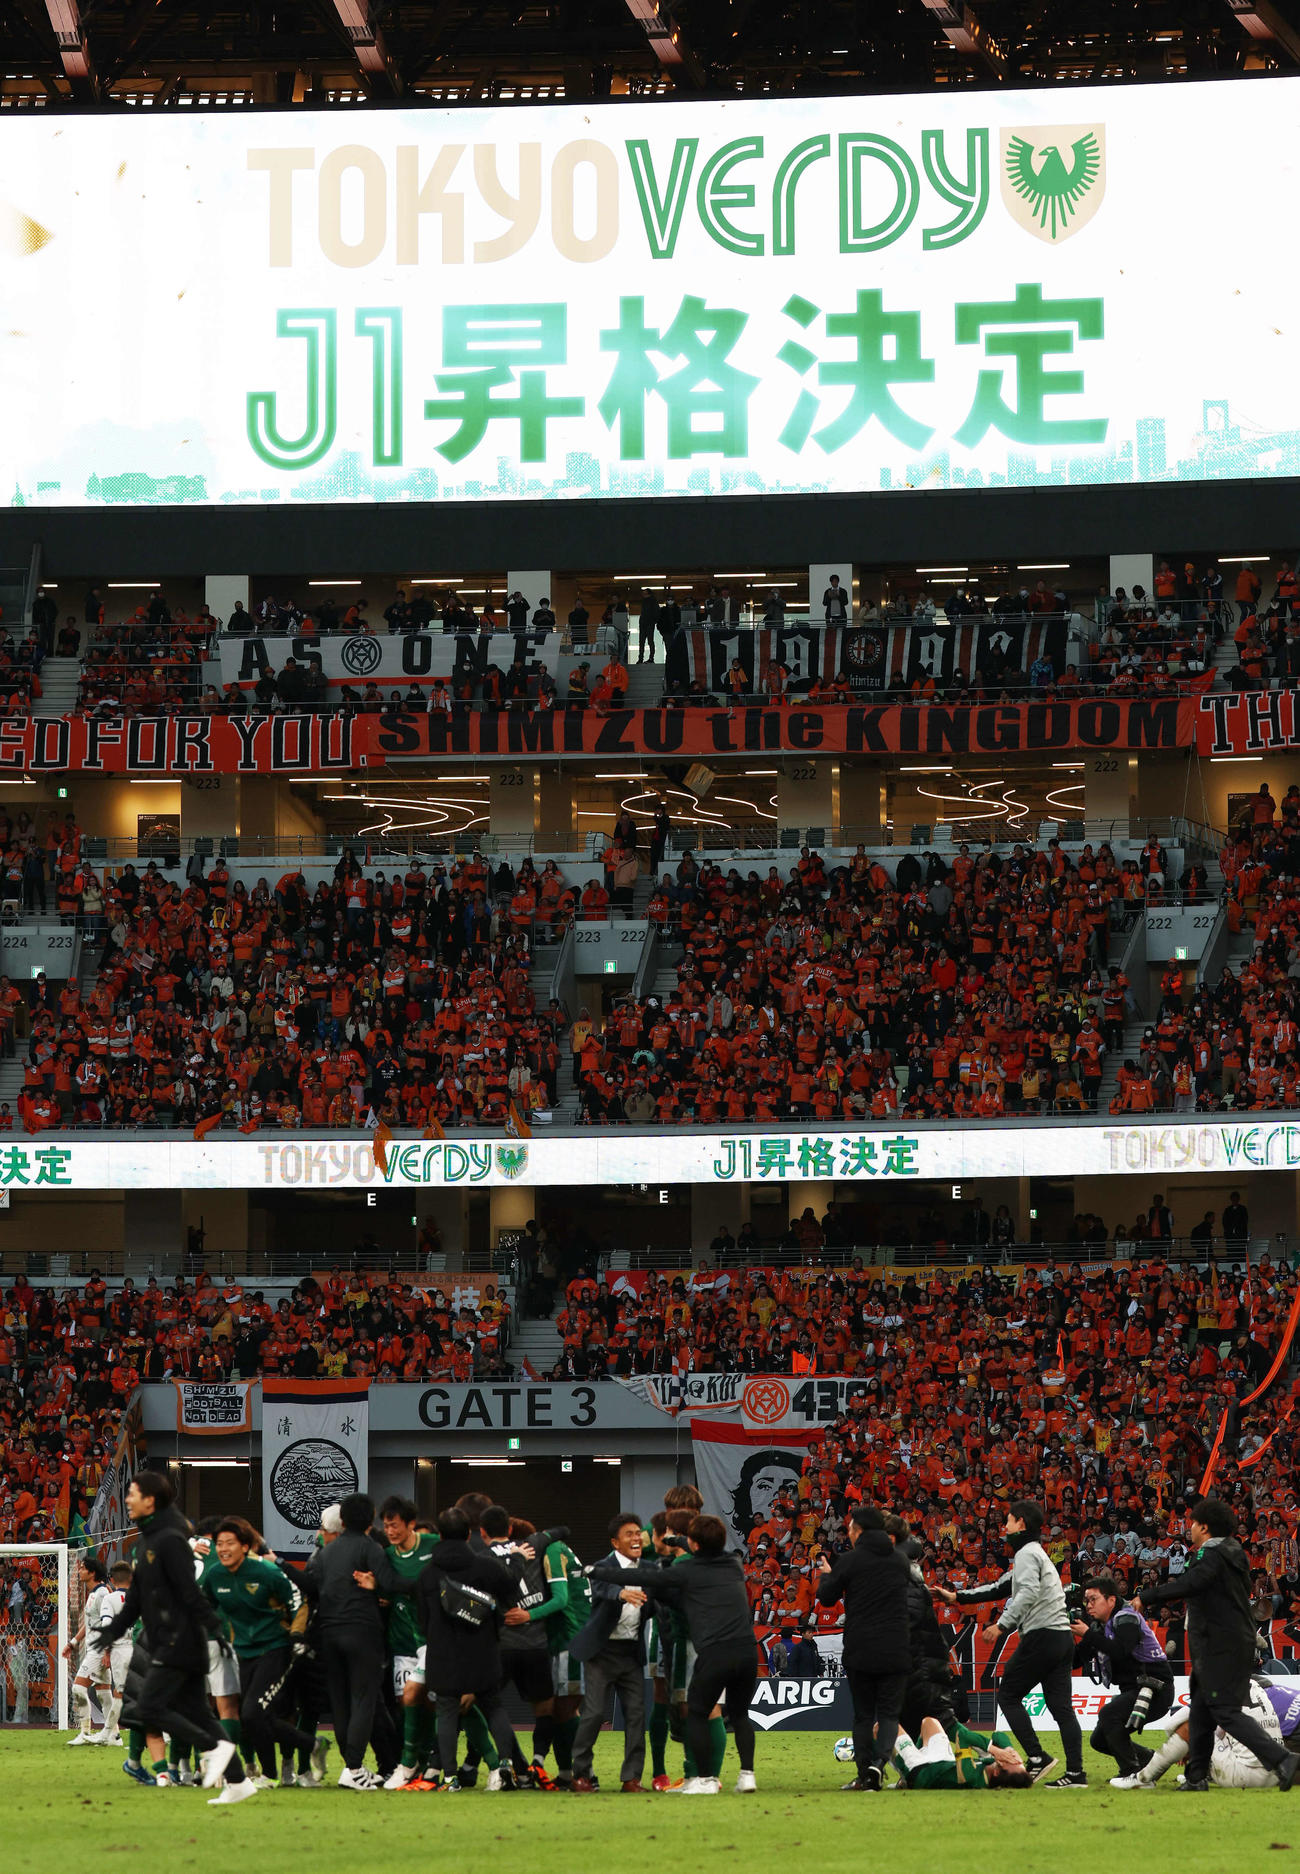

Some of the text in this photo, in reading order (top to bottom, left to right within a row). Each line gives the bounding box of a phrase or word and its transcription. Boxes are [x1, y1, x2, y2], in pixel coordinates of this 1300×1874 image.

[246, 138, 620, 268] TOKYO
[246, 283, 1109, 471] J1昇格決定
[238, 633, 548, 681] AS ONE
[378, 700, 1181, 753] SHIMIZU the KINGDOM
[1200, 689, 1300, 754] TH
[82, 715, 214, 771] FOR
[228, 713, 367, 771] YOU.
[793, 769, 817, 780] 222
[1094, 760, 1119, 772] 222
[196, 778, 221, 790] 223
[500, 774, 524, 786] 223
[1147, 917, 1173, 930] 222
[3, 937, 73, 949] 224 223
[576, 930, 646, 943] 223 222
[714, 1136, 919, 1179] J1昇格決定
[1104, 1128, 1219, 1170] TOKYO
[0, 1146, 72, 1185] 決定
[258, 1145, 375, 1184] TOKYO
[367, 1193, 377, 1206] E
[659, 1190, 669, 1204] E
[952, 1186, 962, 1199] E
[184, 1385, 237, 1395] SHIMIZU
[706, 1373, 744, 1404] KOP
[185, 1411, 241, 1422] NOT DEAD
[418, 1387, 597, 1428] GATE 3
[340, 1416, 357, 1436] 水
